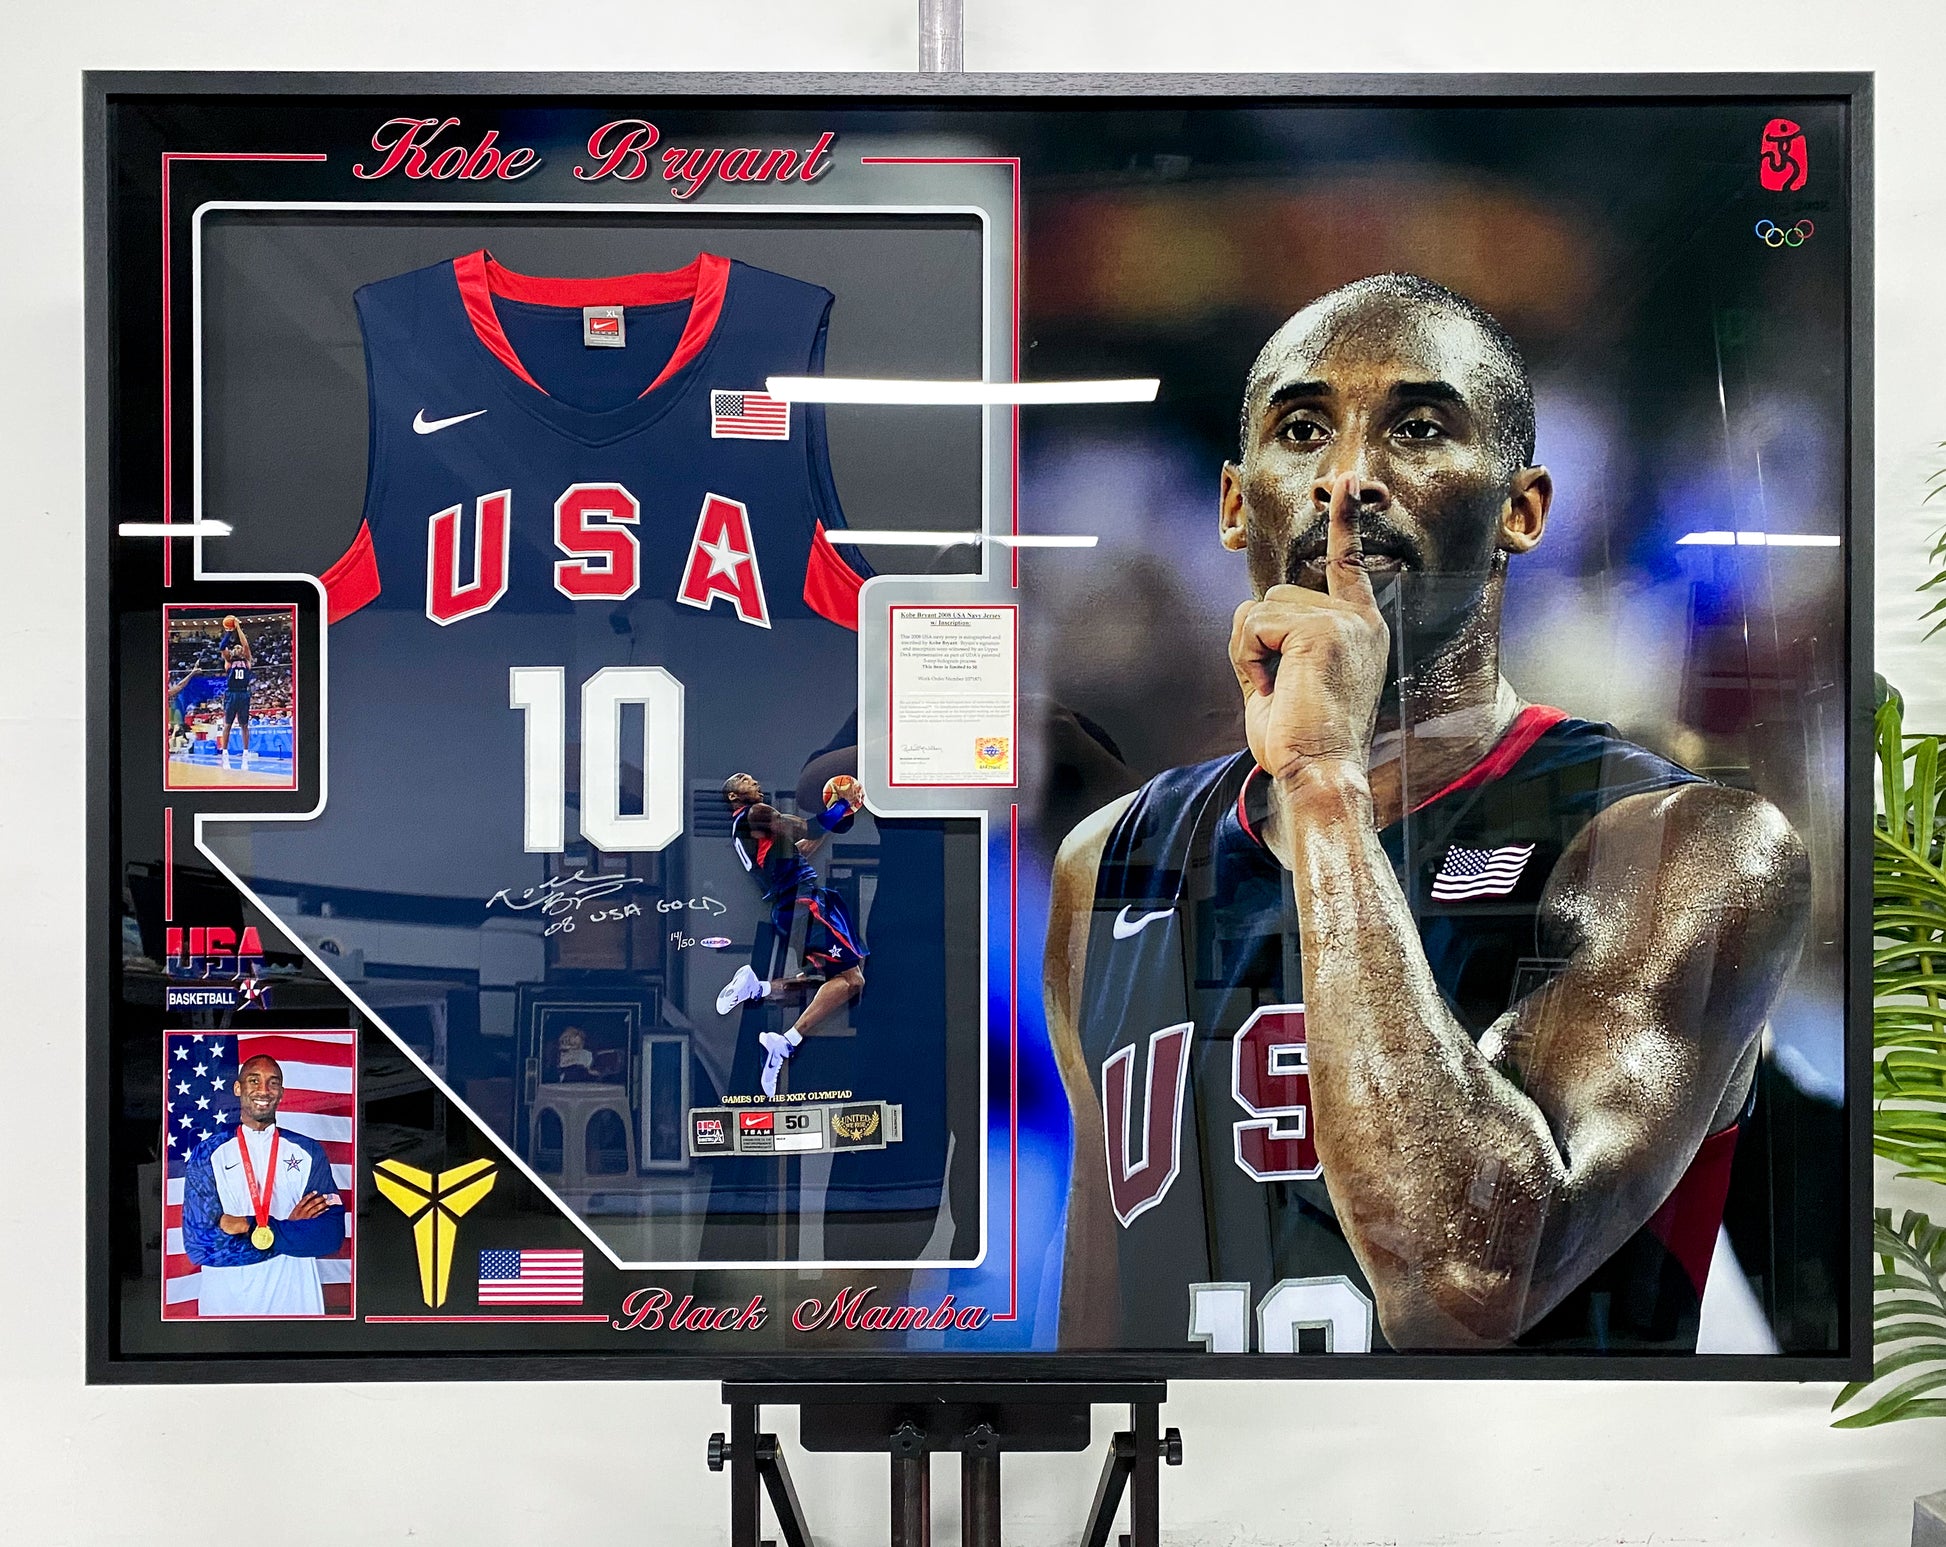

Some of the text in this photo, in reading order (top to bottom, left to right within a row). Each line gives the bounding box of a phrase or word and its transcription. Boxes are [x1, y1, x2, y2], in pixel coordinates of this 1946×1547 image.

[353, 117, 835, 199] Kobe Bryant
[426, 482, 772, 630] USA
[235, 669, 244, 680] 10
[509, 666, 684, 853] 10
[166, 926, 264, 981] USA
[169, 992, 235, 1005] BASKETBALL
[722, 1095, 752, 1104] GAMES
[753, 1095, 766, 1103] OF
[787, 1092, 806, 1102] XXIX
[808, 1090, 853, 1101] OLYMPIAD
[785, 1114, 810, 1130] 50
[841, 1113, 872, 1124] UNITED
[697, 1120, 722, 1136] USA
[612, 1285, 991, 1331] Black Mamba
